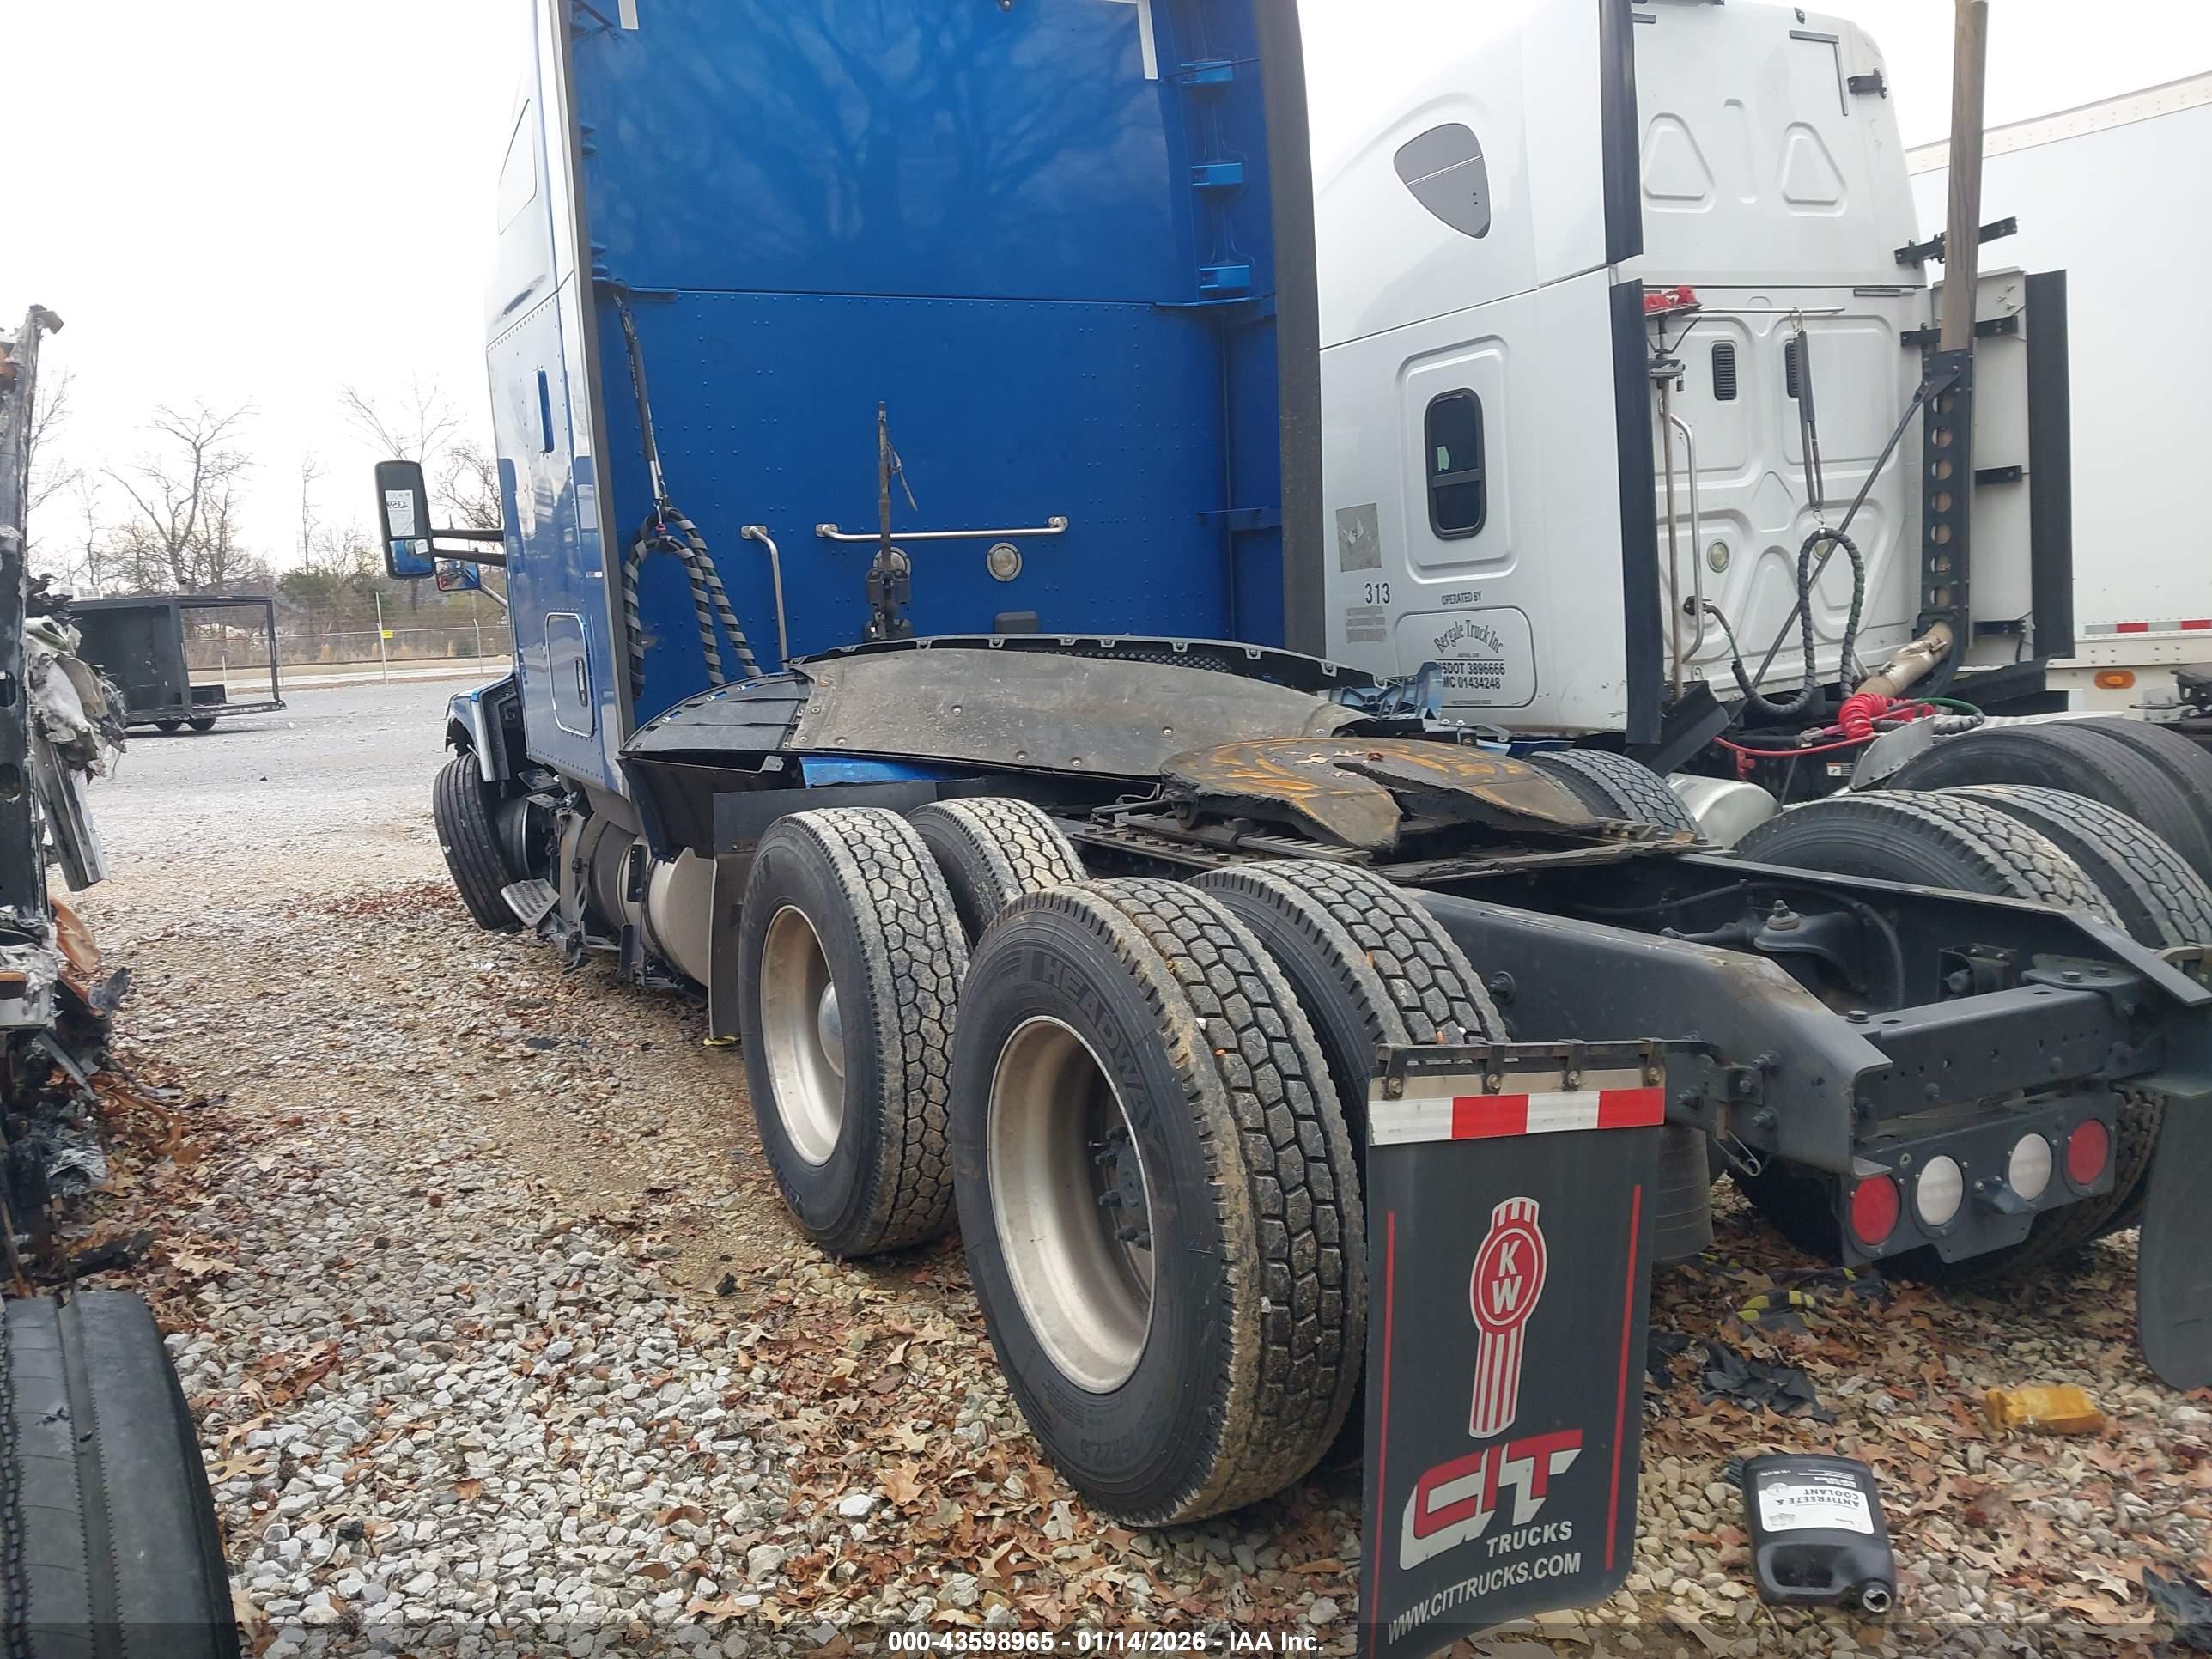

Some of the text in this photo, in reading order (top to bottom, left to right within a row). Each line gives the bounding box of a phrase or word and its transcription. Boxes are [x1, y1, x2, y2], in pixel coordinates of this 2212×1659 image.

[1364, 582, 1390, 604] 313
[1442, 591, 1482, 605] OPERATED BY
[1465, 619, 1490, 644] Truck
[1488, 630, 1504, 653] Inc
[1439, 662, 1505, 675] SDOT 3896666
[1458, 676, 1500, 689] 01434248
[1405, 1429, 1583, 1556] CIT
[1789, 1495, 1860, 1508] ANTIFREEZE
[1804, 1488, 1859, 1500] COOLANT
[1486, 1521, 1573, 1558] TRUCKS
[1388, 1552, 1582, 1645] WWW.CITTRUCKS.COM
